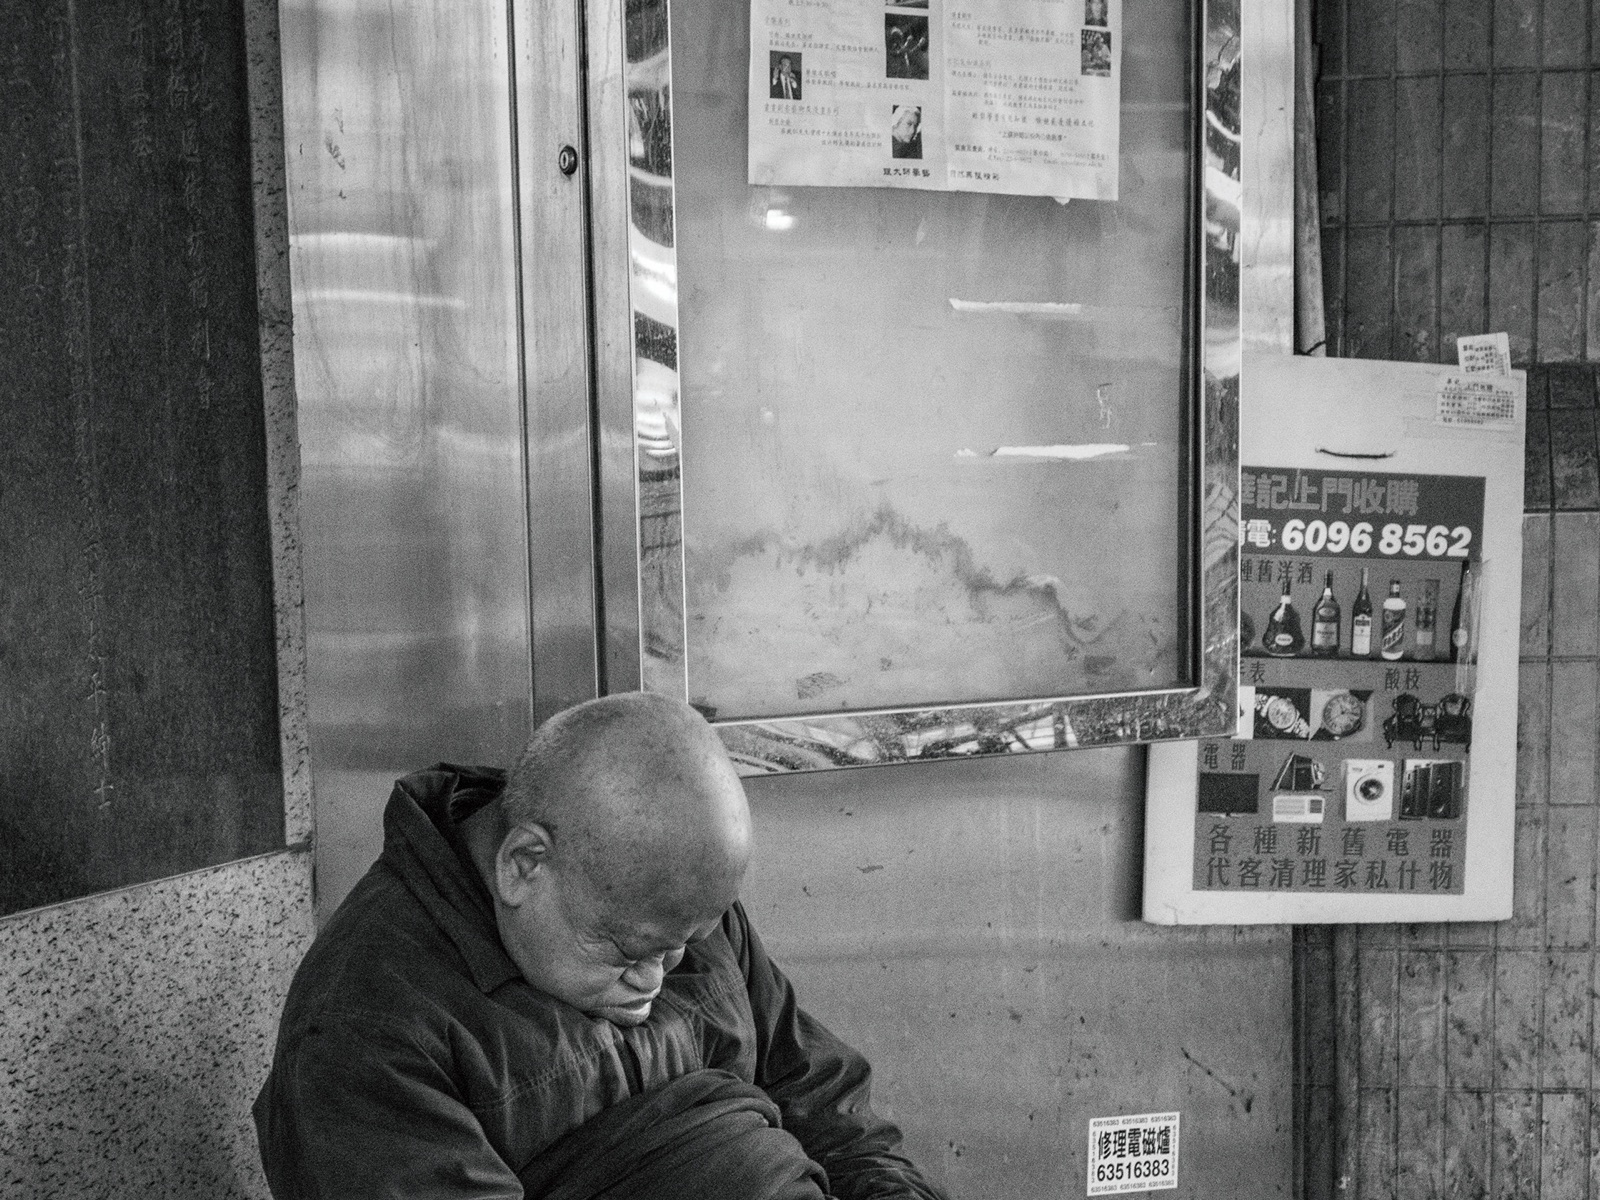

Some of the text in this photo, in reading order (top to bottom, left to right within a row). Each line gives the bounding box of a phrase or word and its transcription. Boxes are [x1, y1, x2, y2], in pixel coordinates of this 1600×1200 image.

[1281, 518, 1374, 554] 6096
[1378, 522, 1472, 557] 8562
[1384, 667, 1422, 691] 酸枝
[1203, 742, 1247, 771] 電器
[1209, 824, 1454, 858] 各種新舊電器
[1206, 856, 1453, 890] 代客清理家私什物
[1097, 1159, 1170, 1182] 63516383
